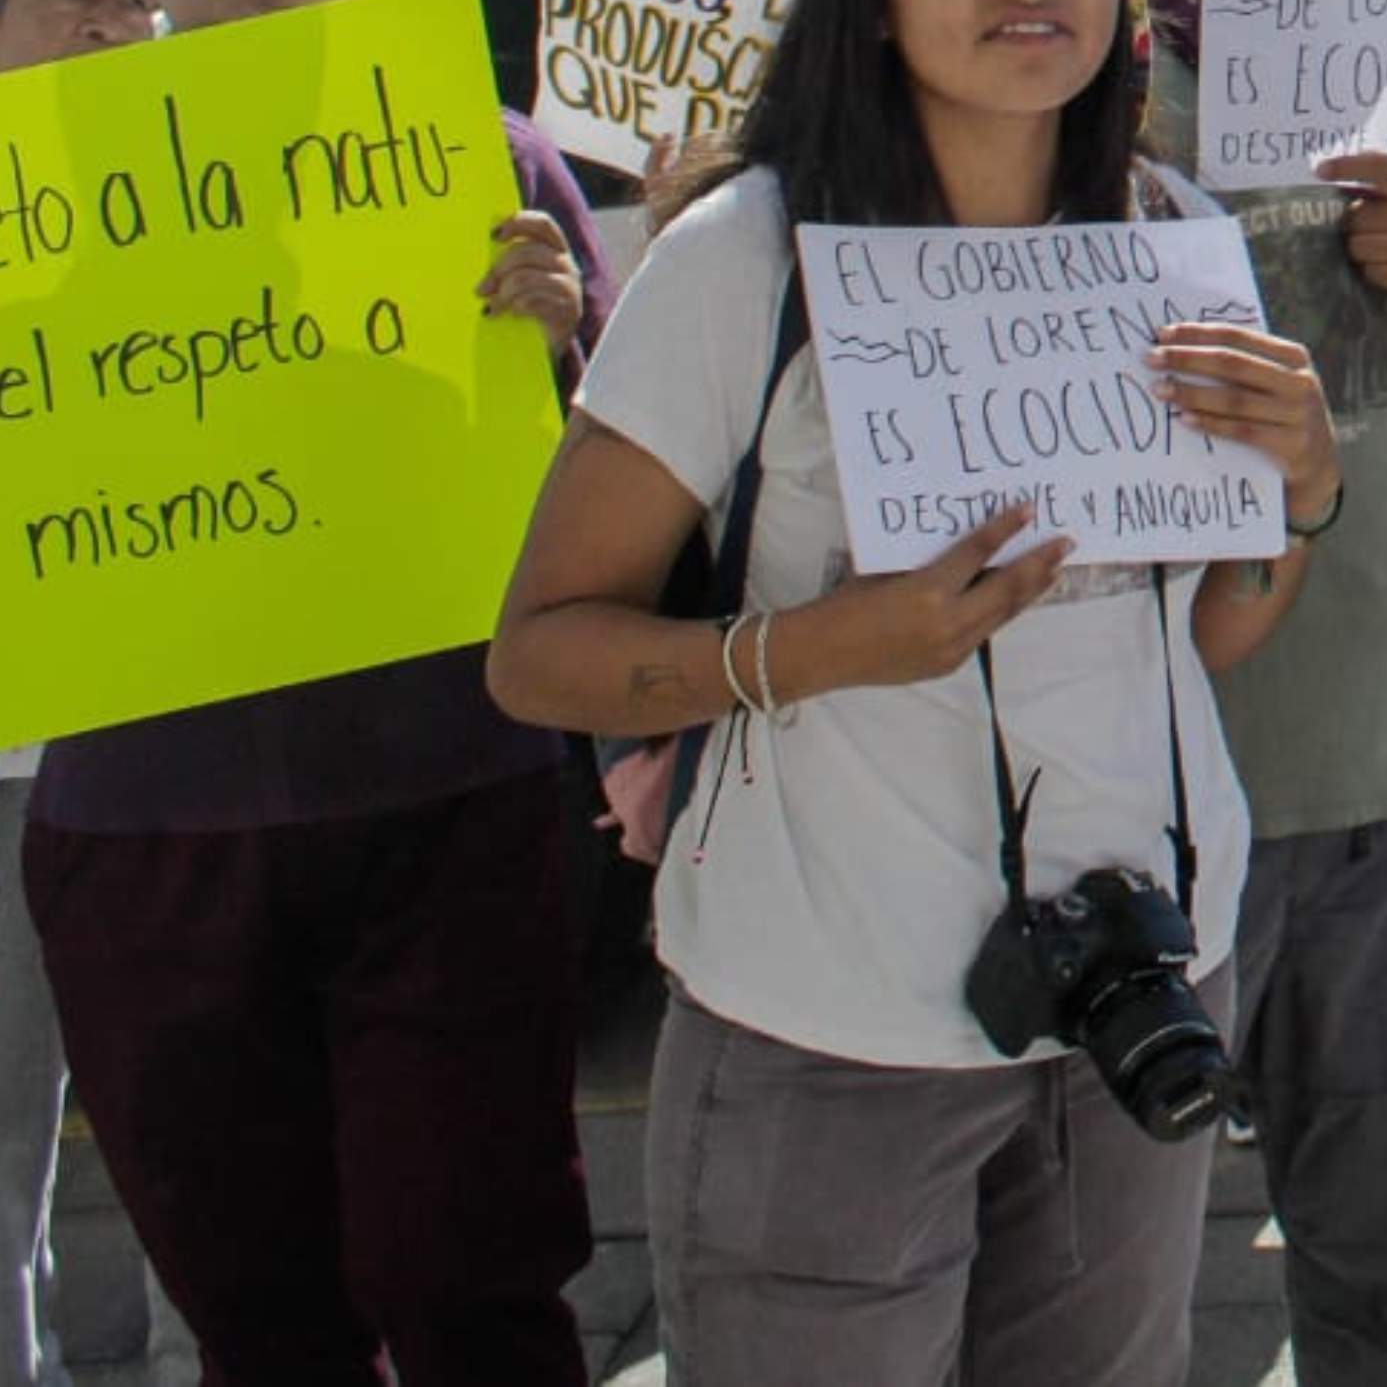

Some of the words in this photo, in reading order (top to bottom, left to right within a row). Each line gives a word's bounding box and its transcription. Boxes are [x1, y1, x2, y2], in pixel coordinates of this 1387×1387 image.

[547, 45, 658, 142] QUE
[1226, 56, 1259, 106] ES
[100, 170, 147, 247] a
[165, 93, 245, 233] la
[834, 239, 898, 307] EL
[916, 229, 1161, 302] GOBIERNO
[91, 285, 325, 422] respeto
[365, 297, 405, 356] a
[903, 325, 964, 380] DE
[985, 296, 1187, 365] LORENA
[865, 407, 915, 466] ES
[26, 468, 323, 580] mismos.
[1115, 474, 1264, 538] ANIQUILA
